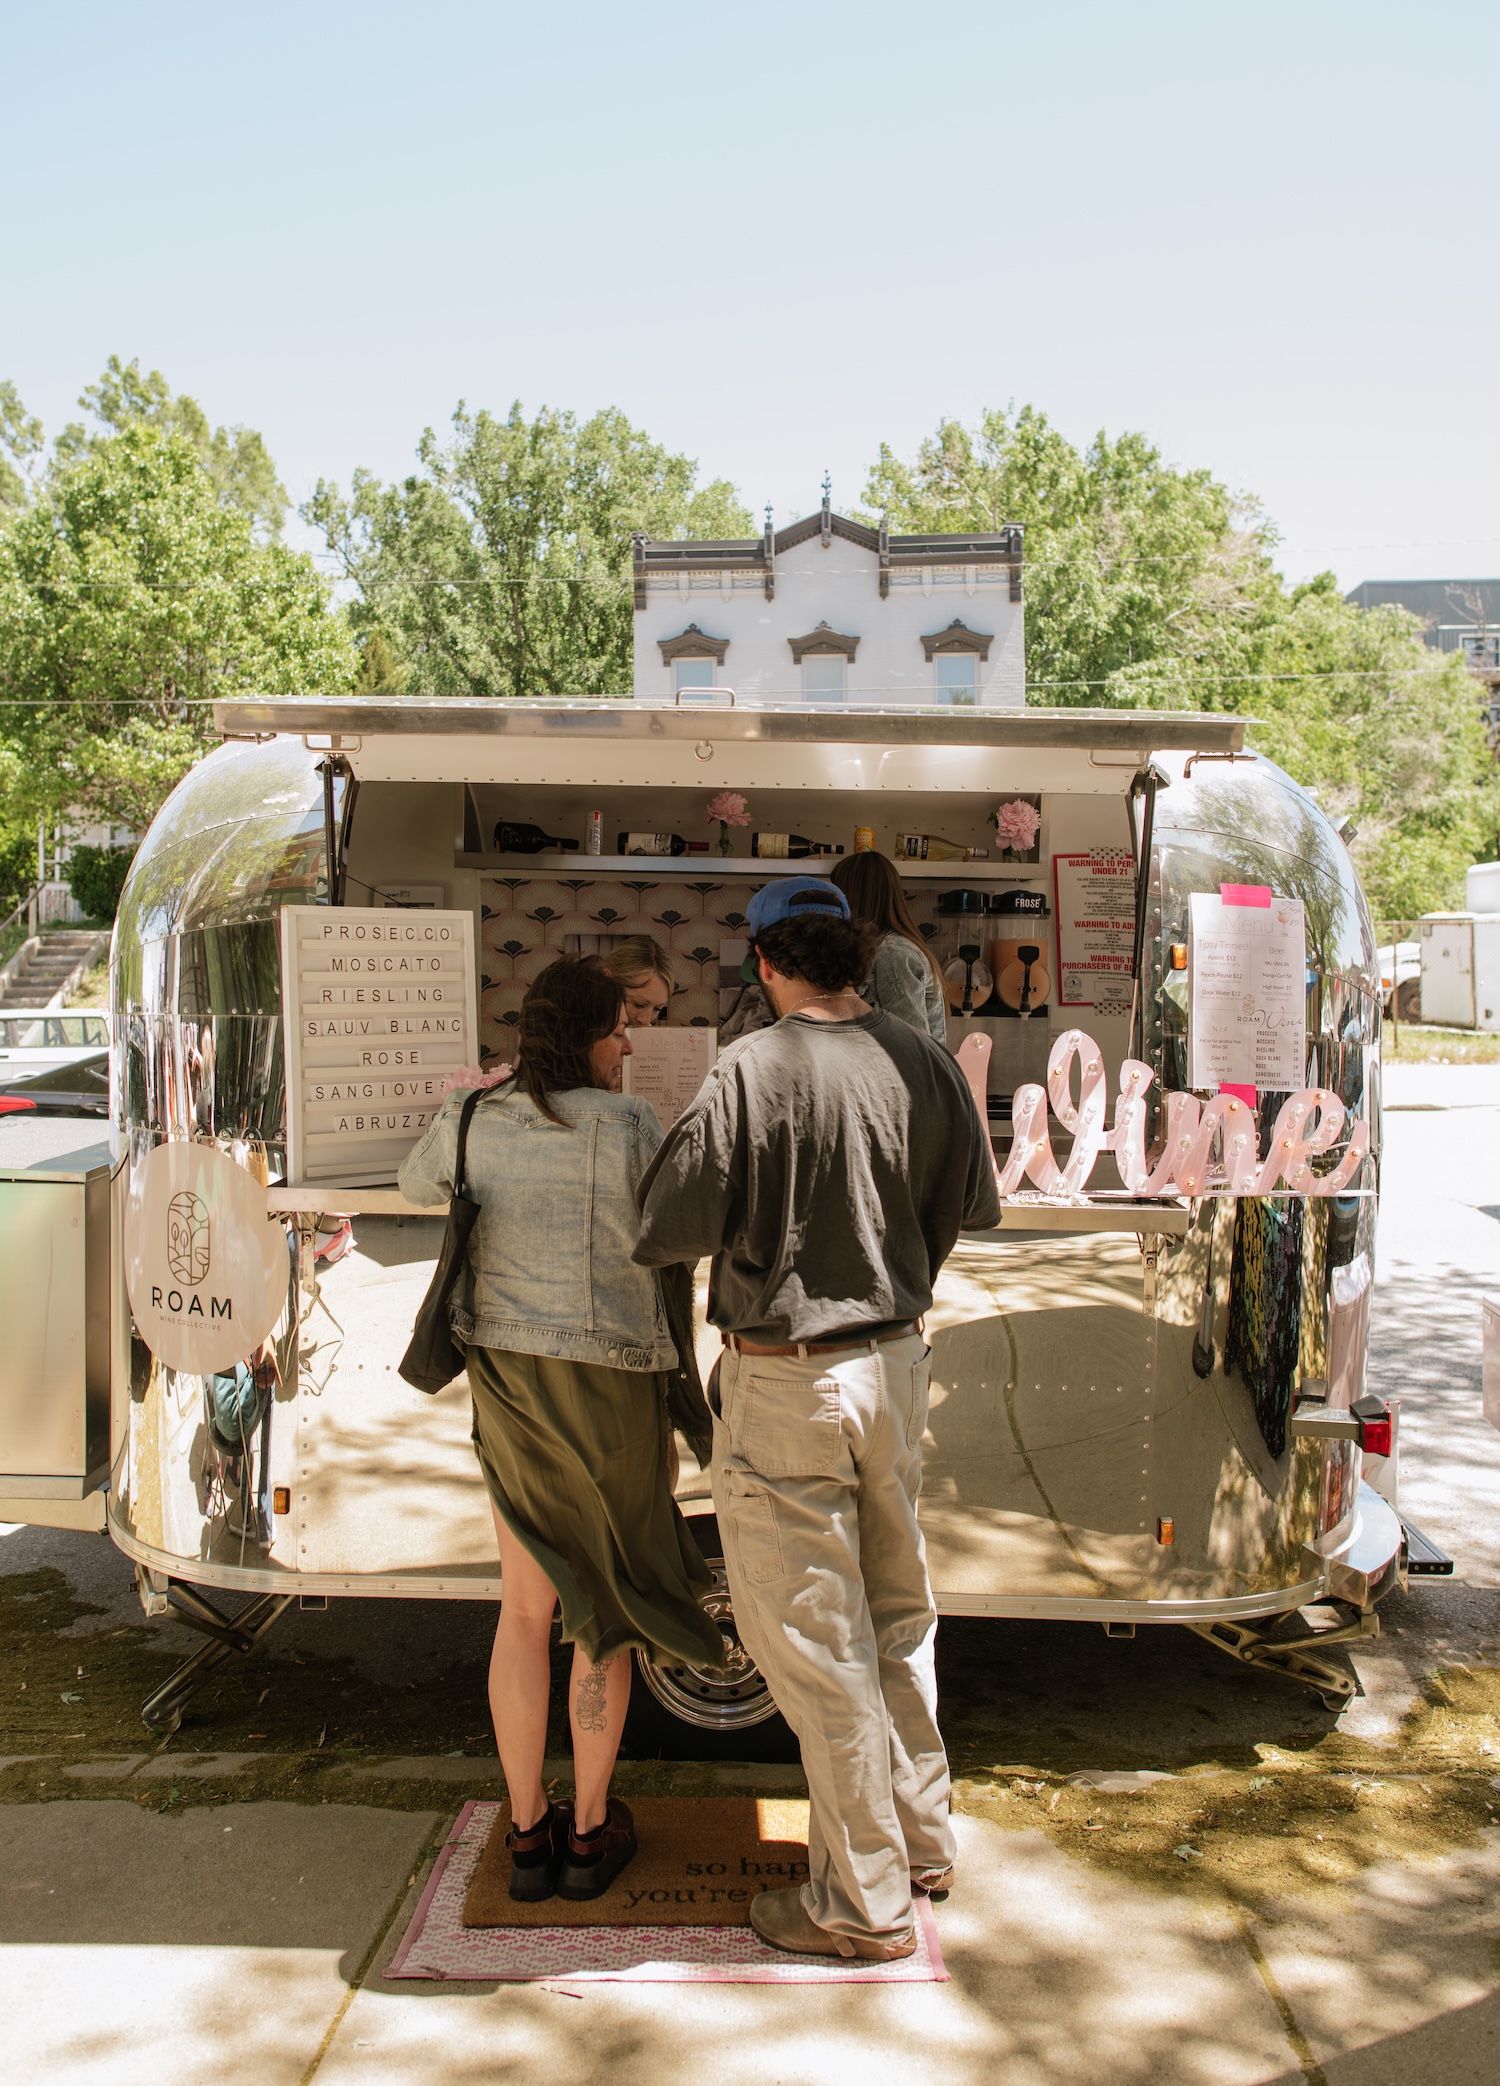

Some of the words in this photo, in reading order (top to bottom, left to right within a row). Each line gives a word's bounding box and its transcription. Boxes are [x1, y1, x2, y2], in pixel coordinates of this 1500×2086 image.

[1068, 859, 1104, 868] WARNING
[1106, 860, 1116, 868] TO
[1092, 867, 1118, 876] UNDER
[1119, 868, 1128, 876] 21
[1074, 921, 1109, 929] WARNING
[1111, 921, 1120, 929] TO
[1224, 913, 1273, 934] Menu
[323, 925, 450, 941] PROSECCO
[1197, 939, 1218, 950] Tipsy
[1220, 940, 1249, 951] Tinnies!
[1269, 946, 1286, 955] Beer
[331, 957, 441, 972] MOSCATO
[1090, 955, 1124, 964] WARNING
[1062, 963, 1111, 971] PURCHASERS
[1233, 972, 1243, 980] $12
[322, 988, 443, 1003] RIESLING
[1237, 1015, 1261, 1024] ROAM
[1250, 1006, 1304, 1030] Wine
[307, 1021, 371, 1036] SAUV
[390, 1019, 462, 1034] BLANC
[651, 1038, 686, 1051] Menu
[362, 1051, 420, 1066] ROSE
[632, 1055, 647, 1063] Tipsy
[647, 1055, 668, 1063] Tinnies!
[152, 1286, 232, 1321] ROAM
[160, 1315, 176, 1325] WINE
[176, 1318, 222, 1332] COLLECTIVE
[685, 1862, 727, 1878] so
[739, 1857, 808, 1882] hap
[623, 1885, 749, 1911] you're
